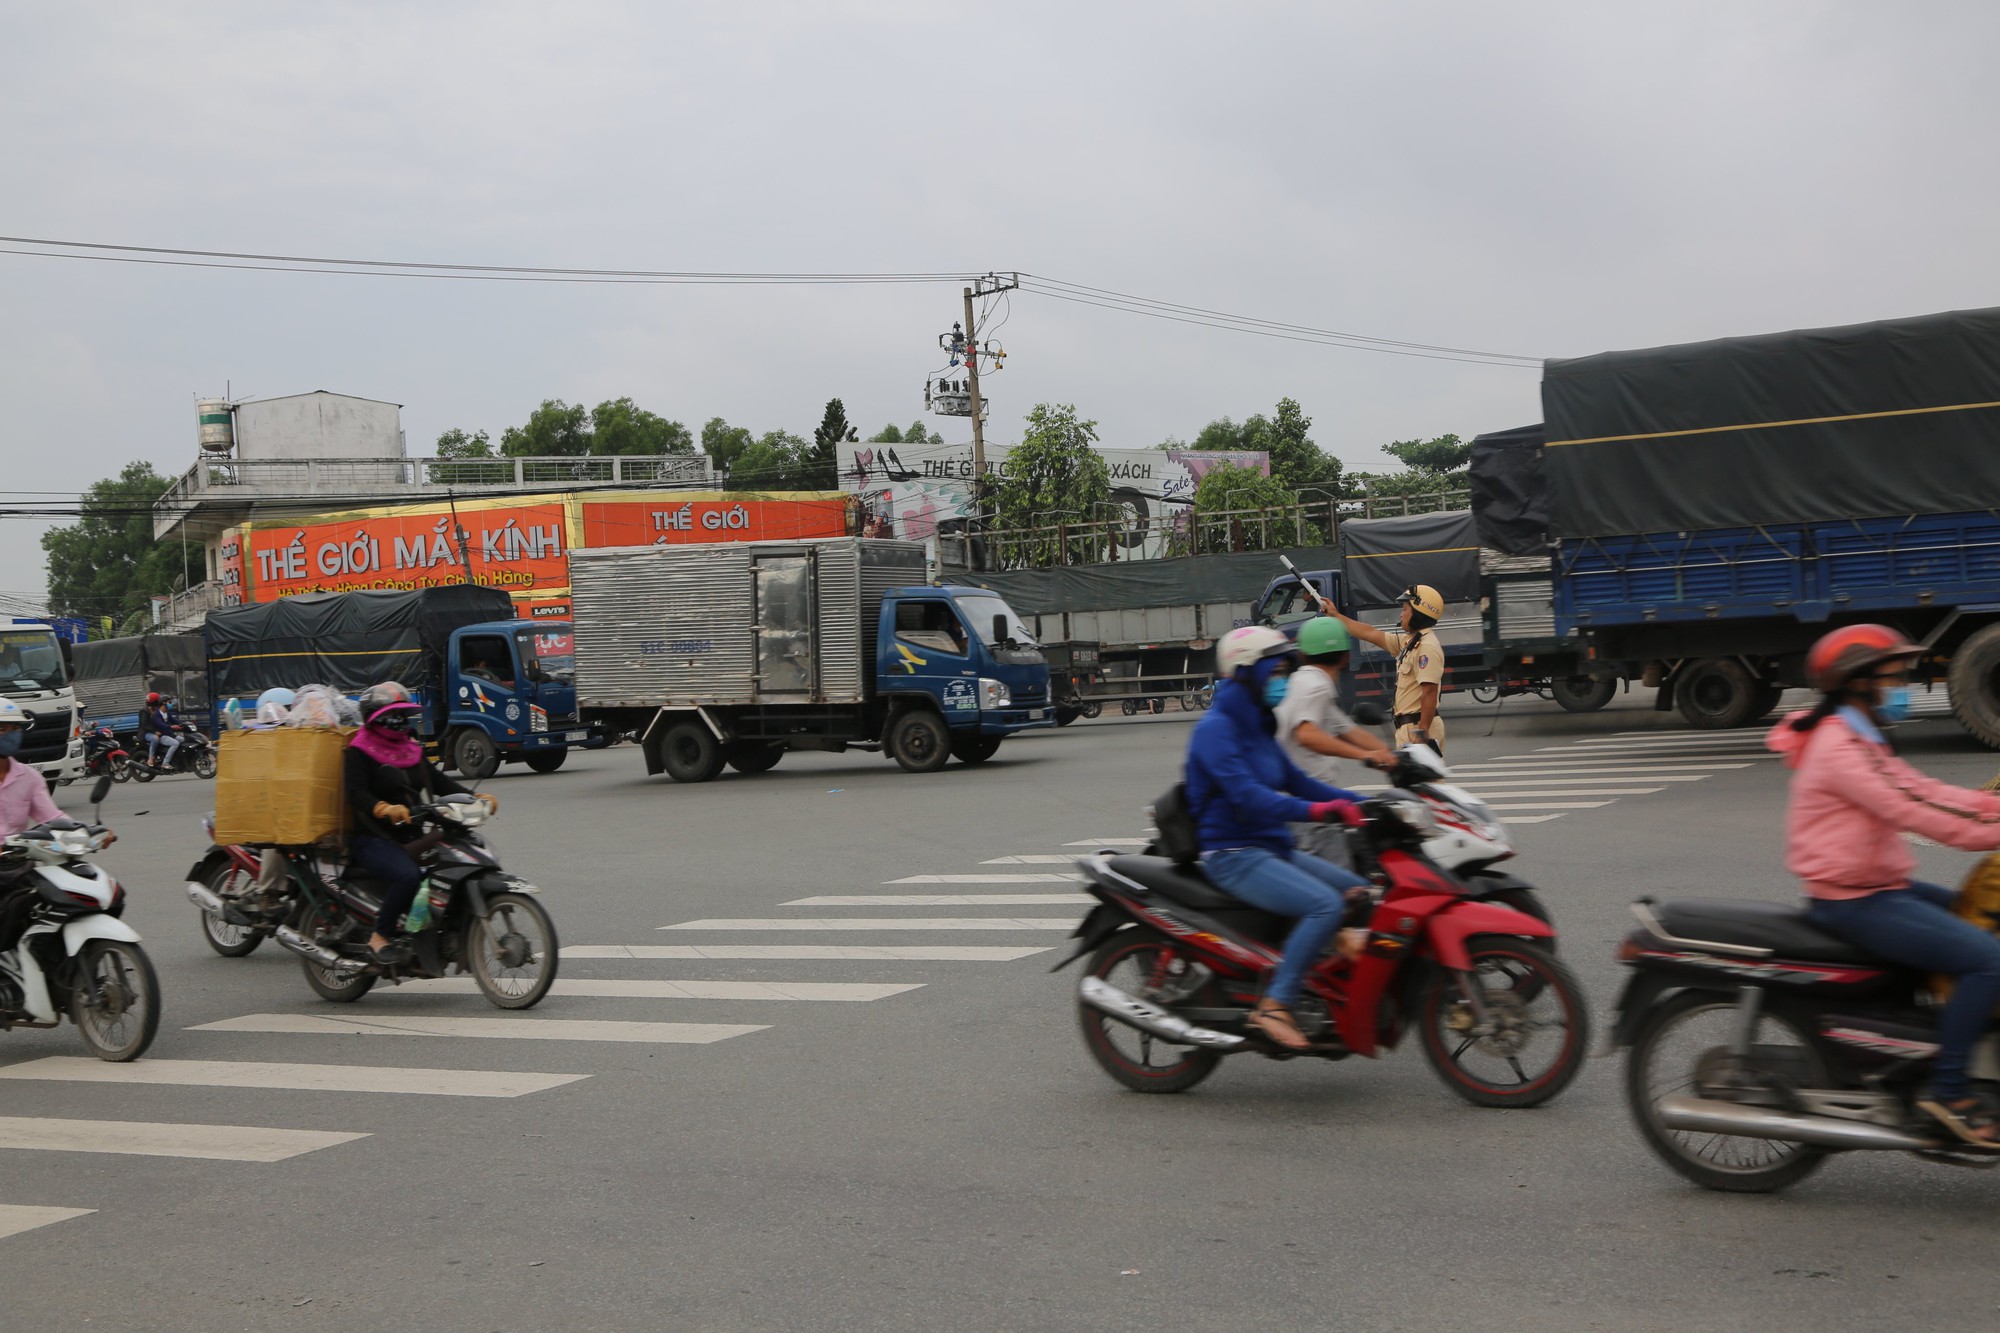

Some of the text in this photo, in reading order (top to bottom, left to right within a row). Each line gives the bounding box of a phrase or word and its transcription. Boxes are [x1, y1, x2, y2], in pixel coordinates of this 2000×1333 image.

[1112, 460, 1151, 479] XÁCH
[1163, 475, 1190, 497] Sale
[652, 502, 749, 530] THẾ GIỚI
[256, 530, 307, 581] THẾ
[317, 529, 380, 577] GIỚI
[481, 518, 562, 564] KÍNH
